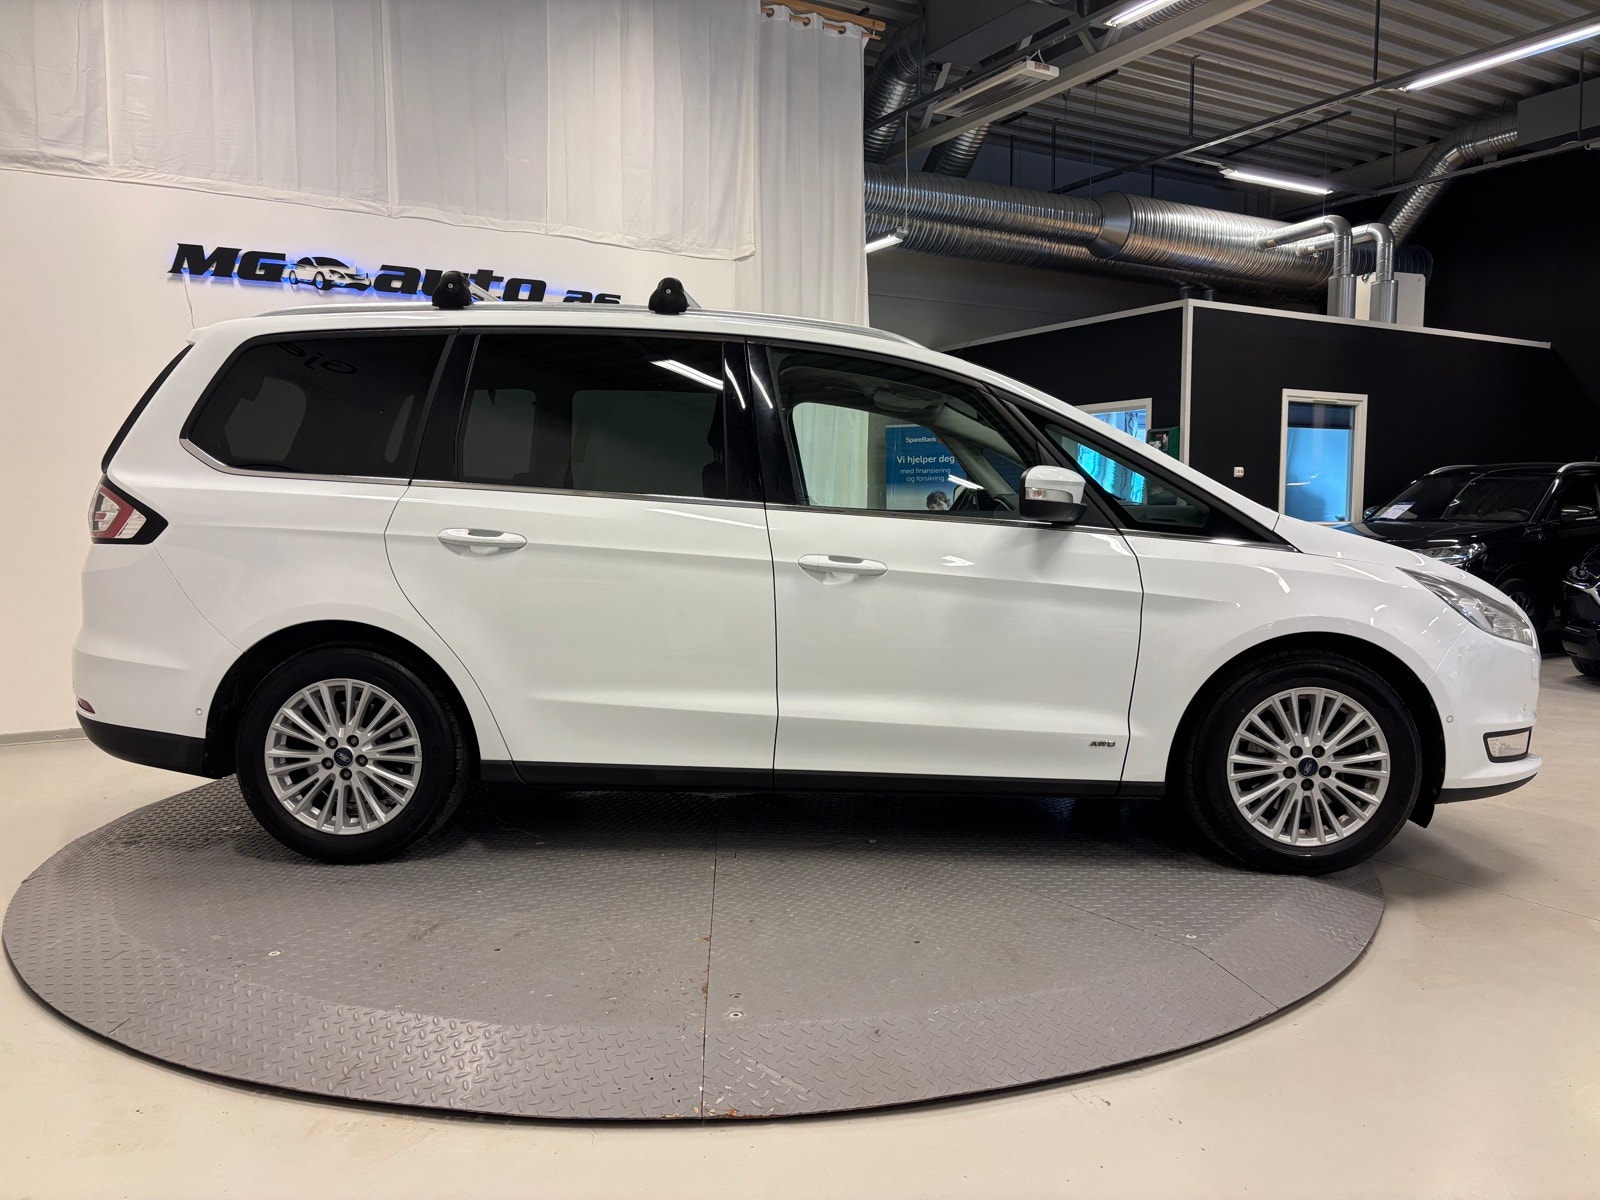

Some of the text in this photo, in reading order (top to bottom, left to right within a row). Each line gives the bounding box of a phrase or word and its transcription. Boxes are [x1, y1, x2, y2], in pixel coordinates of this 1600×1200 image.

[167, 242, 287, 282] MG
[896, 455, 955, 465] Vi hjelper deg
